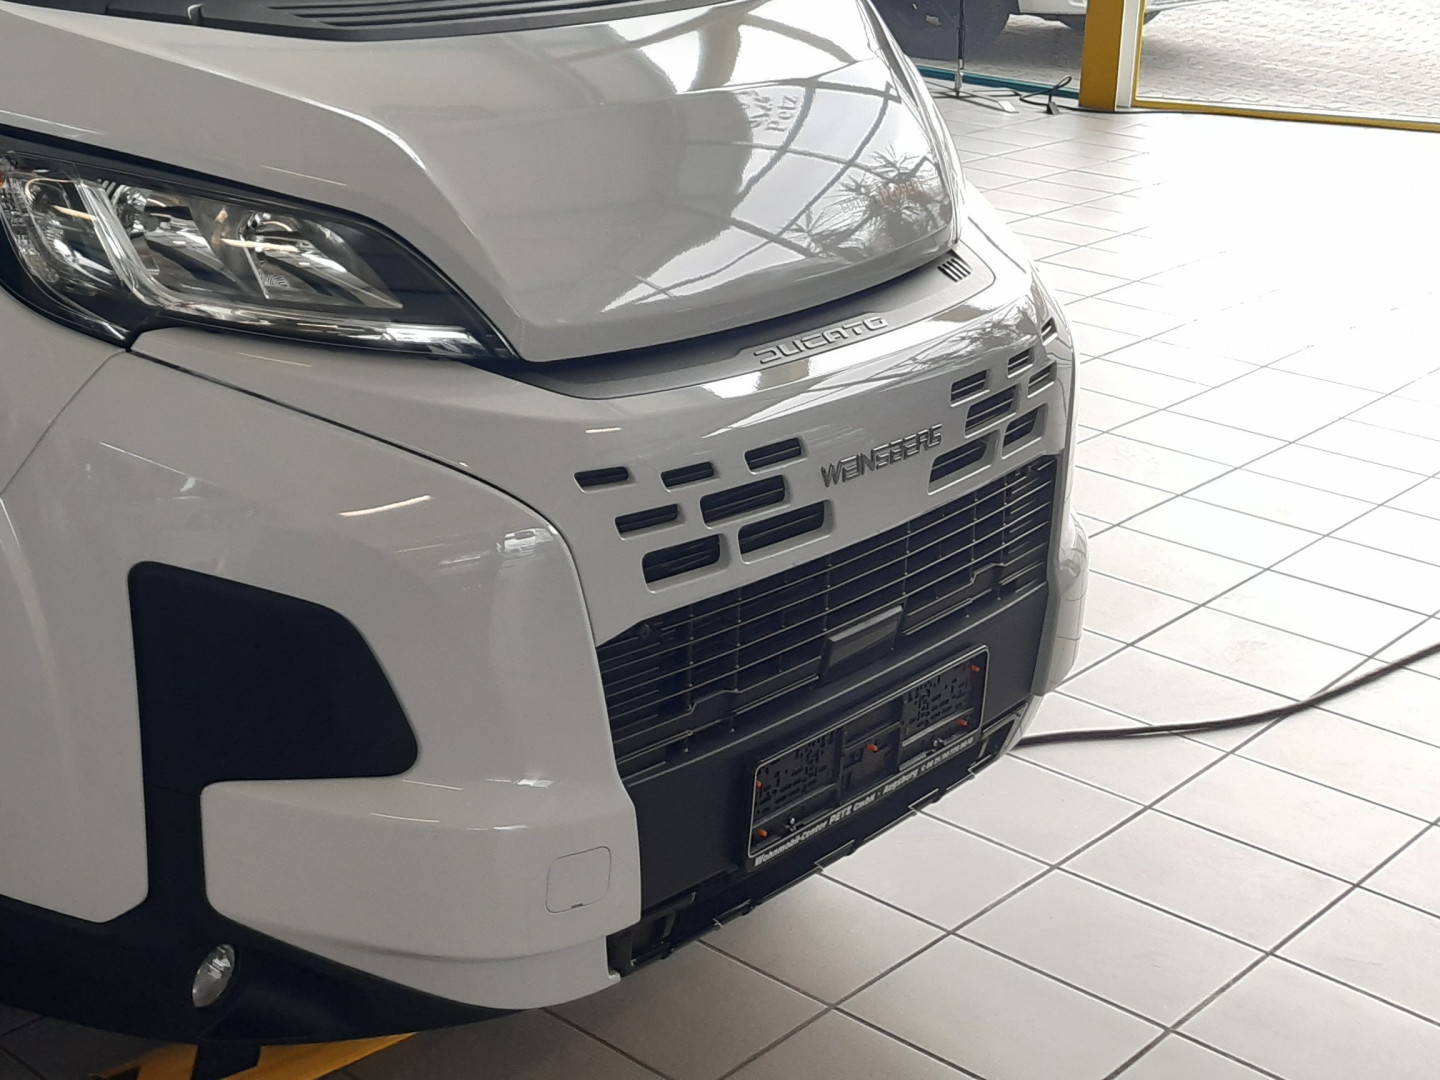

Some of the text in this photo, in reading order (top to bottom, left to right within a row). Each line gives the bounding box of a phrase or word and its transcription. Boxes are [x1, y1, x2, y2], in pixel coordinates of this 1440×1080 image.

[753, 316, 890, 365] DUCATO
[820, 424, 944, 487] WEINSBERG
[828, 806, 853, 826] PETZ
